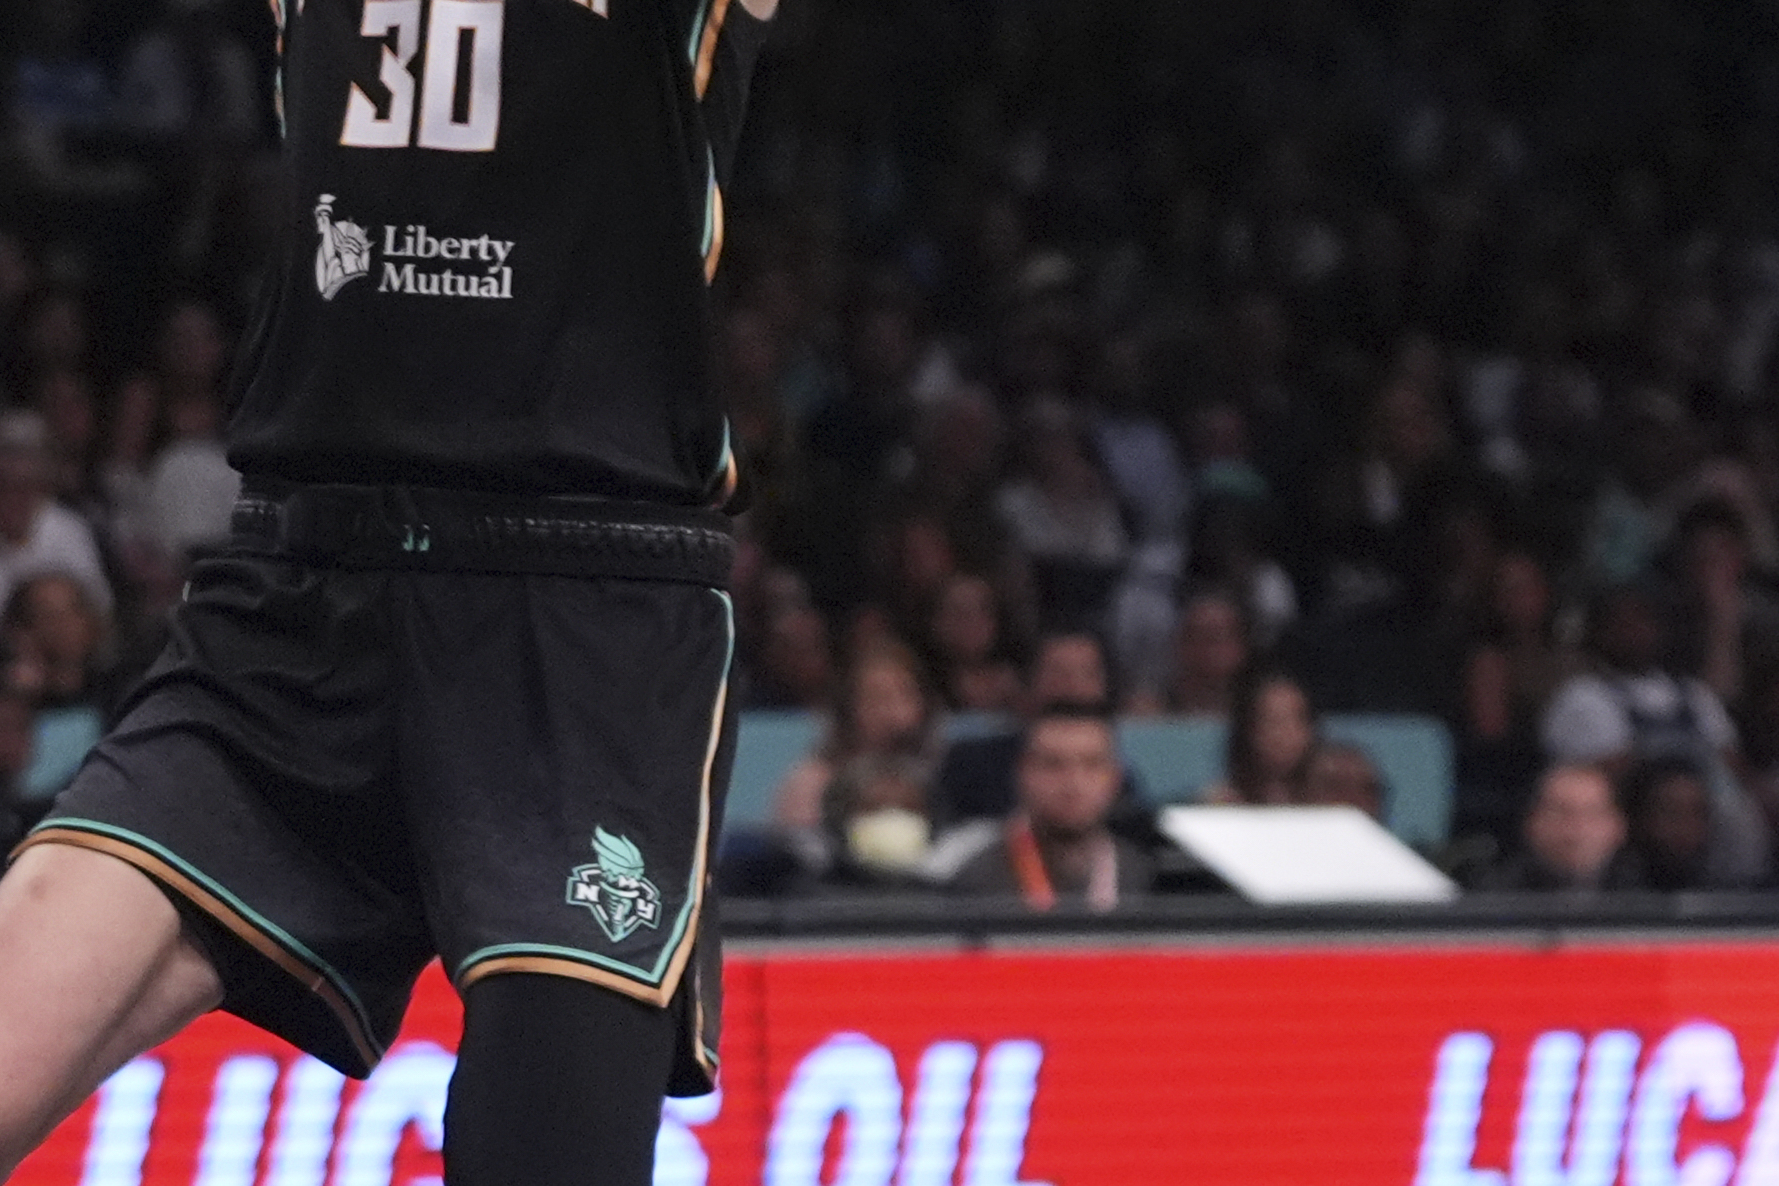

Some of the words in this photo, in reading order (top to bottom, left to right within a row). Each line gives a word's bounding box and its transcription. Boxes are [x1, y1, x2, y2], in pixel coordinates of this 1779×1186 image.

[383, 225, 516, 274] Liberty
[378, 262, 513, 299] Mutual
[762, 1031, 1066, 1186] OIL
